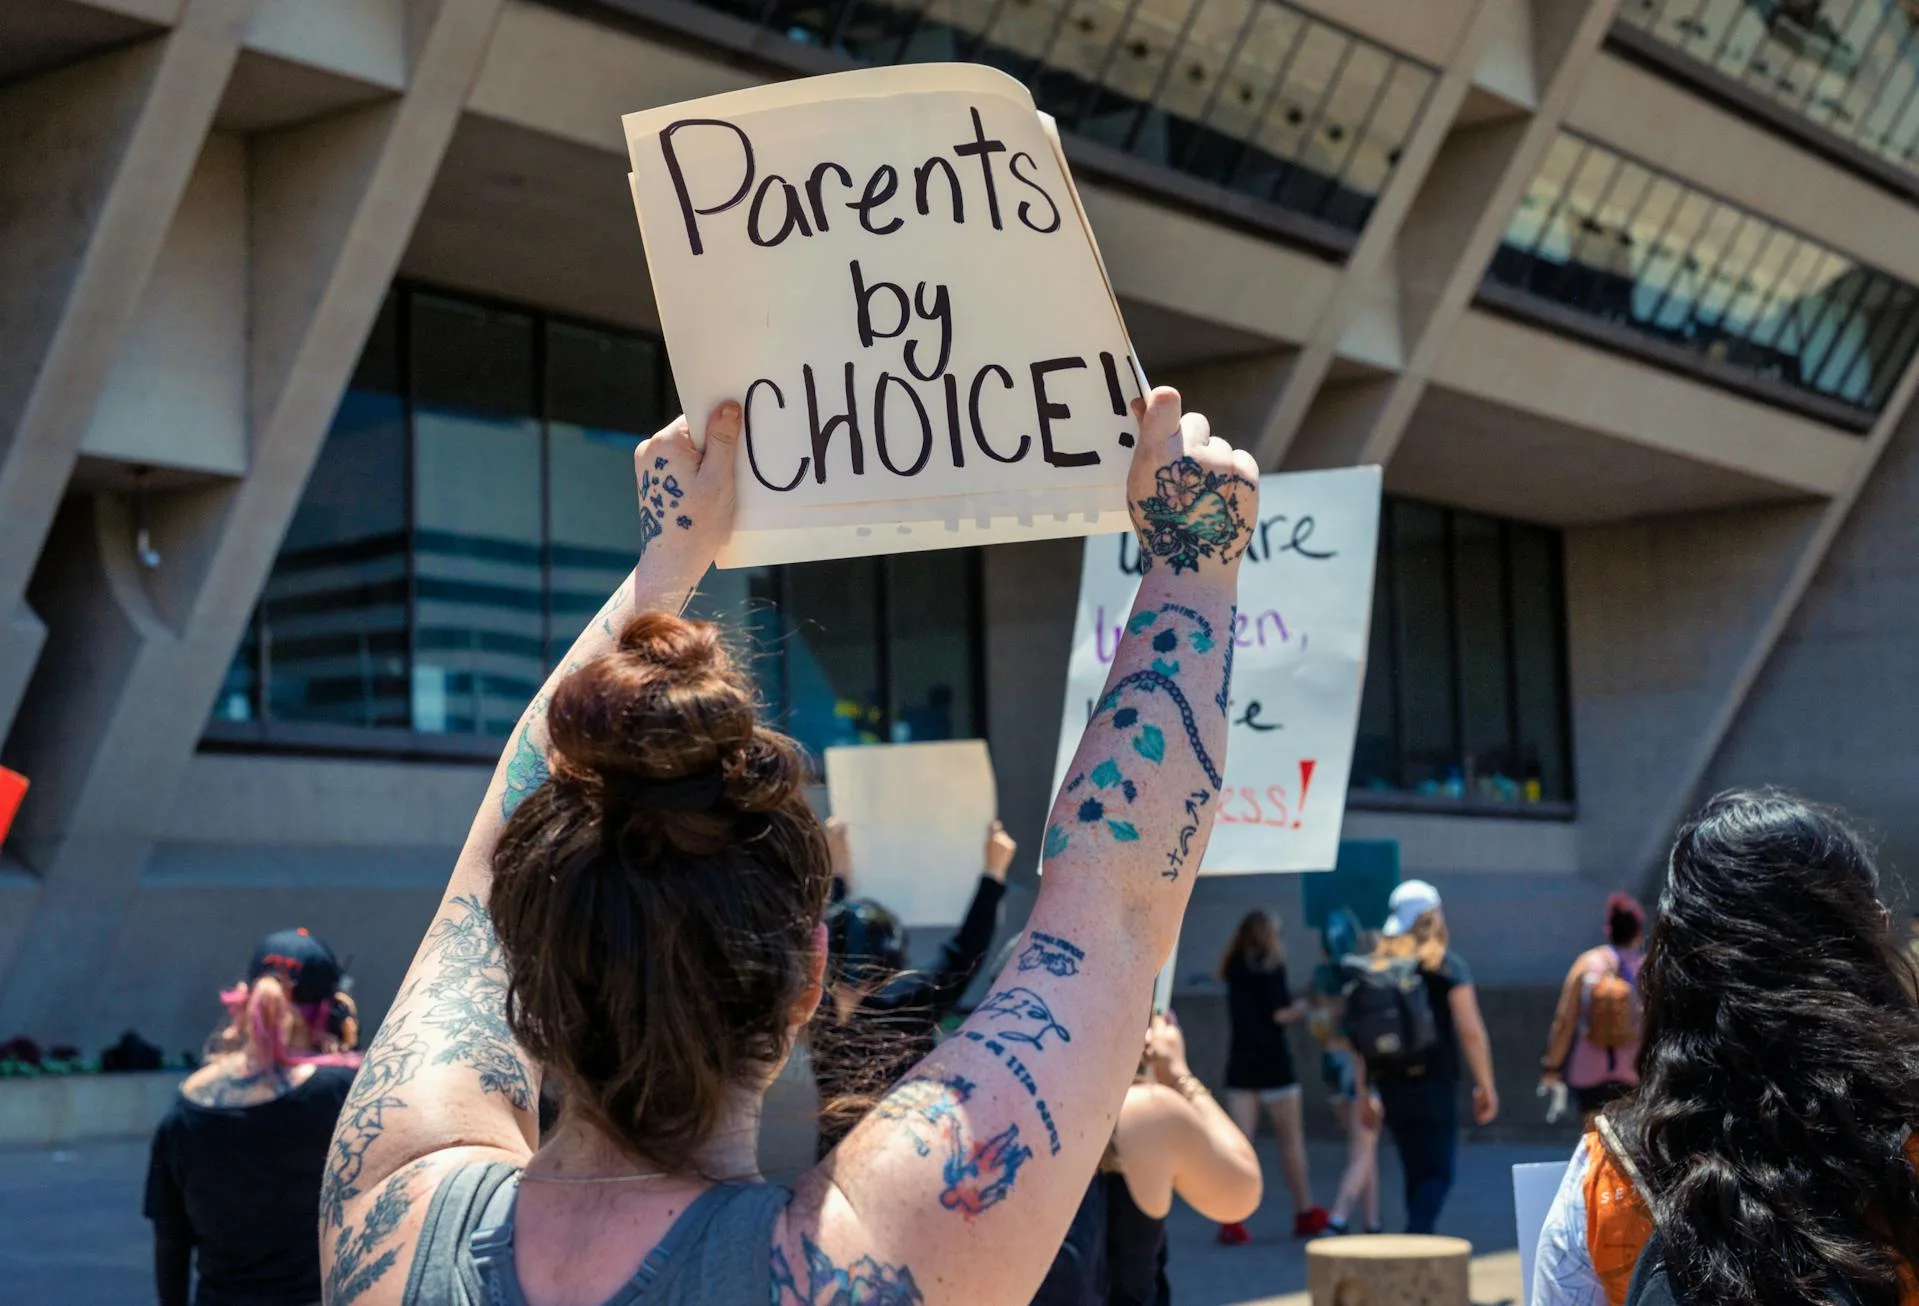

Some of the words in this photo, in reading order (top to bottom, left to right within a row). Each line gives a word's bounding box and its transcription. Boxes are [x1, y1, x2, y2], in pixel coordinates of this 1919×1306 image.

[659, 106, 1061, 256] Parents
[849, 260, 952, 381] by
[1247, 515, 1338, 563] re
